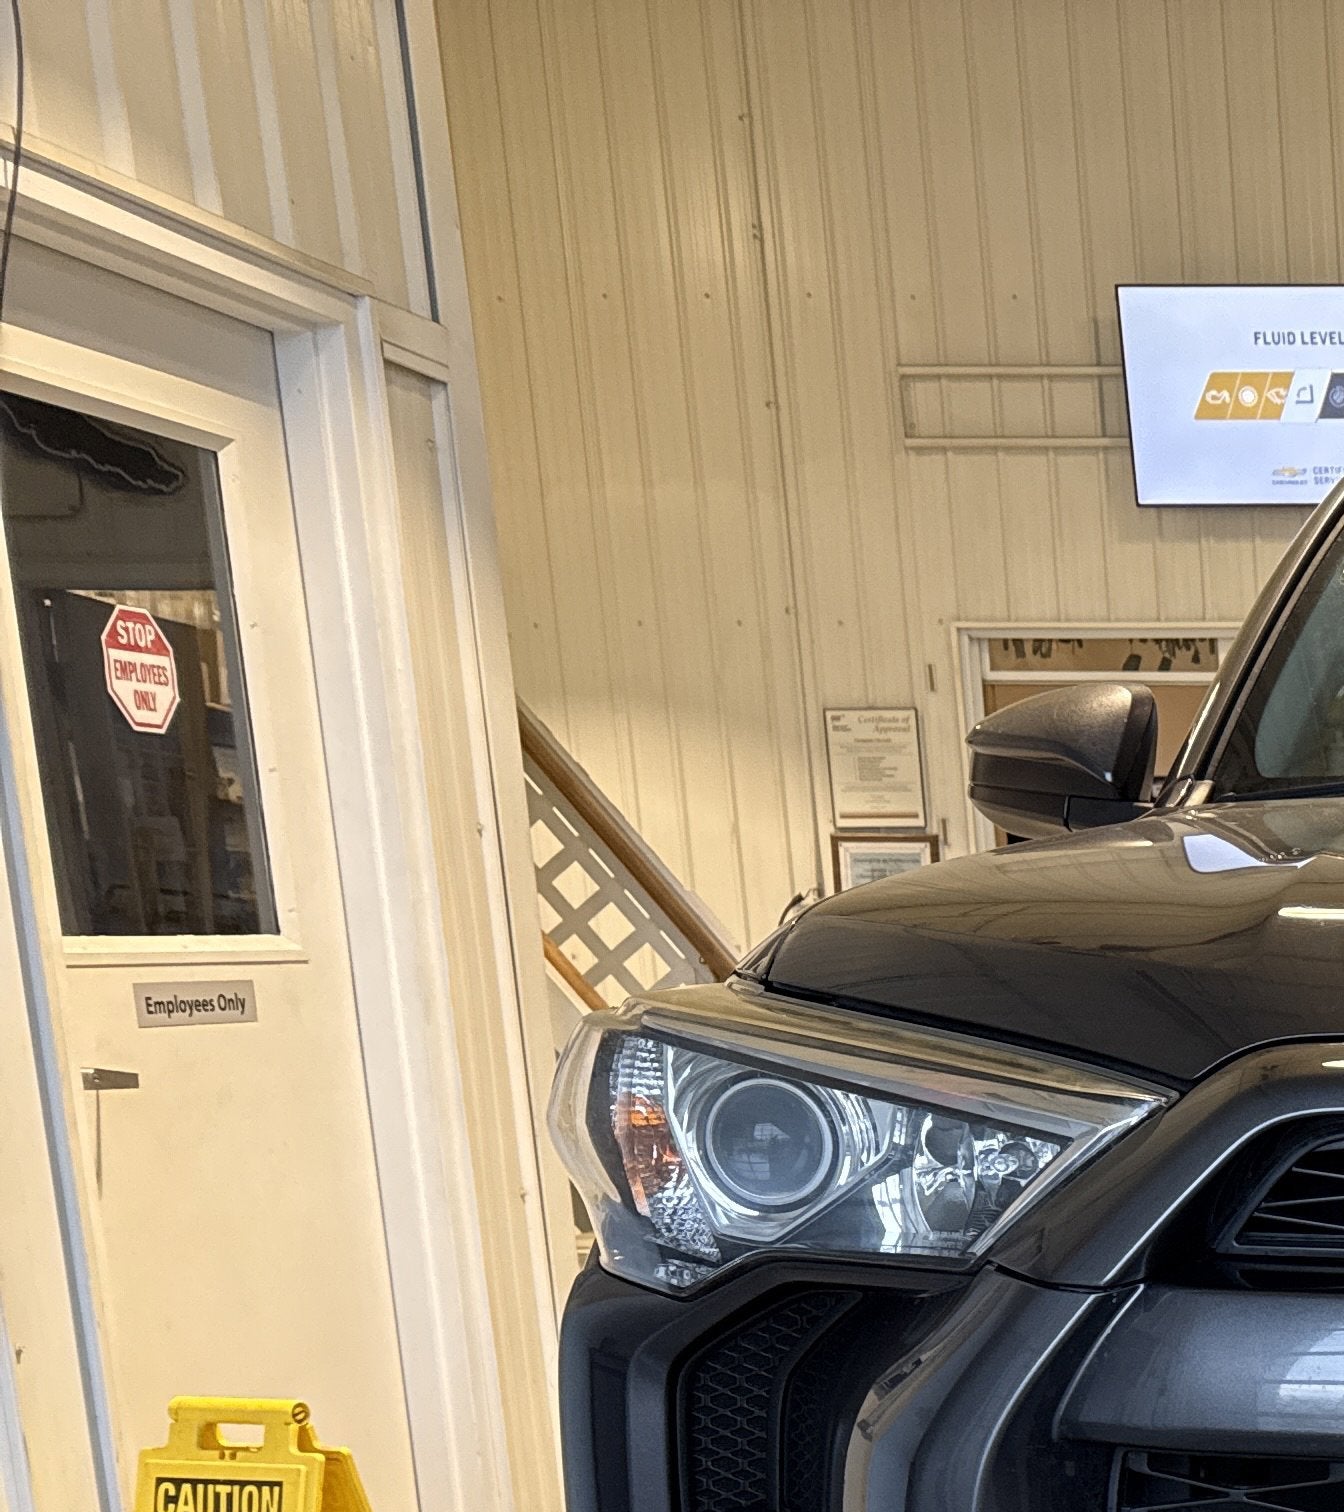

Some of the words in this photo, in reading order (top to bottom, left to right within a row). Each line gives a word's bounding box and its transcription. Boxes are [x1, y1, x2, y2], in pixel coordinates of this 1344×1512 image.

[1253, 331, 1296, 345] FLUID
[116, 620, 156, 648] STOP
[113, 659, 169, 687] EMPLOYEES
[133, 689, 157, 713] ONLY
[144, 994, 215, 1018] Employees
[217, 992, 246, 1015] Only
